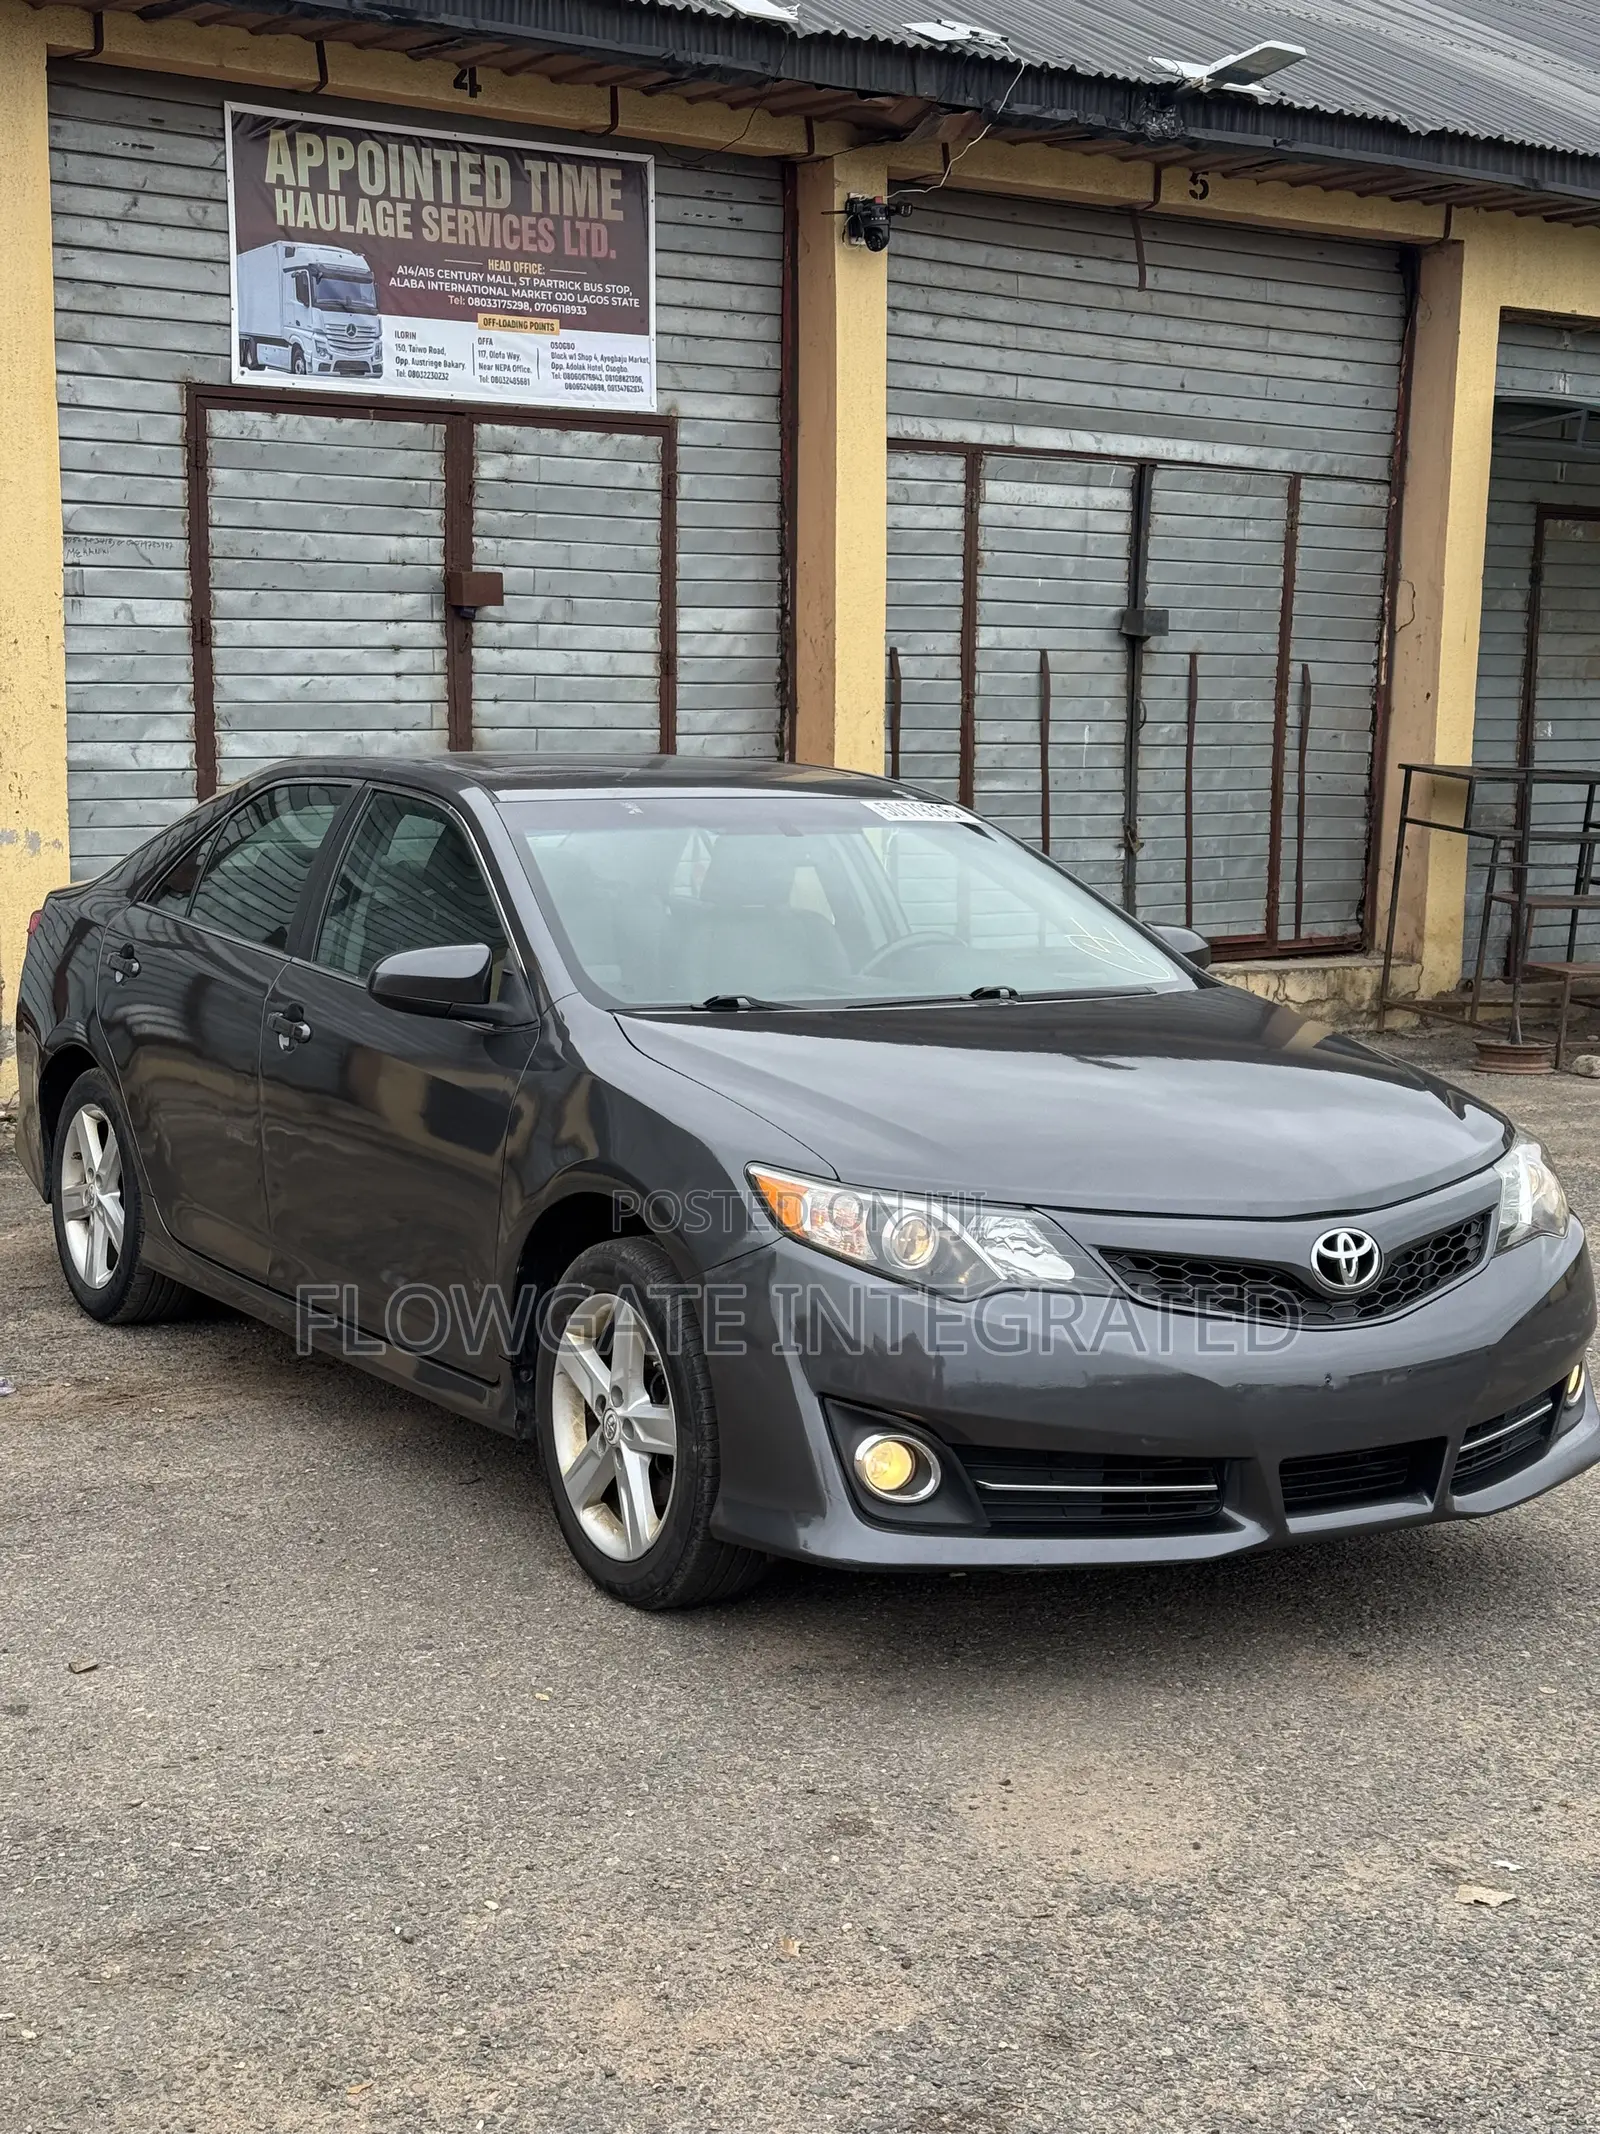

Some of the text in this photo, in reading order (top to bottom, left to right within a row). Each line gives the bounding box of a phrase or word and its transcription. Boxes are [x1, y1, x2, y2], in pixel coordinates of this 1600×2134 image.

[453, 66, 482, 98] 4
[265, 129, 624, 221] APPOINTED TIME
[1189, 171, 1209, 200] 5
[275, 189, 617, 259] HAULAGE SERVICES LTD.
[488, 259, 546, 275] HEAD OFFICE:
[397, 265, 633, 297] A14/A15 CENTURY MALL, ST PARTRICK BUS STOP,
[389, 277, 641, 308] ALABA INTERNATIONAL MARKET OJO LAGOS STATE
[448, 295, 588, 316] Tel: 08033175298, 0706118933
[483, 317, 555, 332] OFF-LOADING POINTS
[394, 330, 417, 340] ILORIN
[477, 336, 494, 346] OFFA
[395, 343, 447, 356] 150, Taiwo Road,
[550, 341, 576, 351] OSOGBO
[395, 356, 411, 367] Opp.
[550, 351, 568, 360] Block
[577, 353, 593, 362] Shop
[478, 362, 494, 371] Near
[495, 363, 512, 373] NEPA
